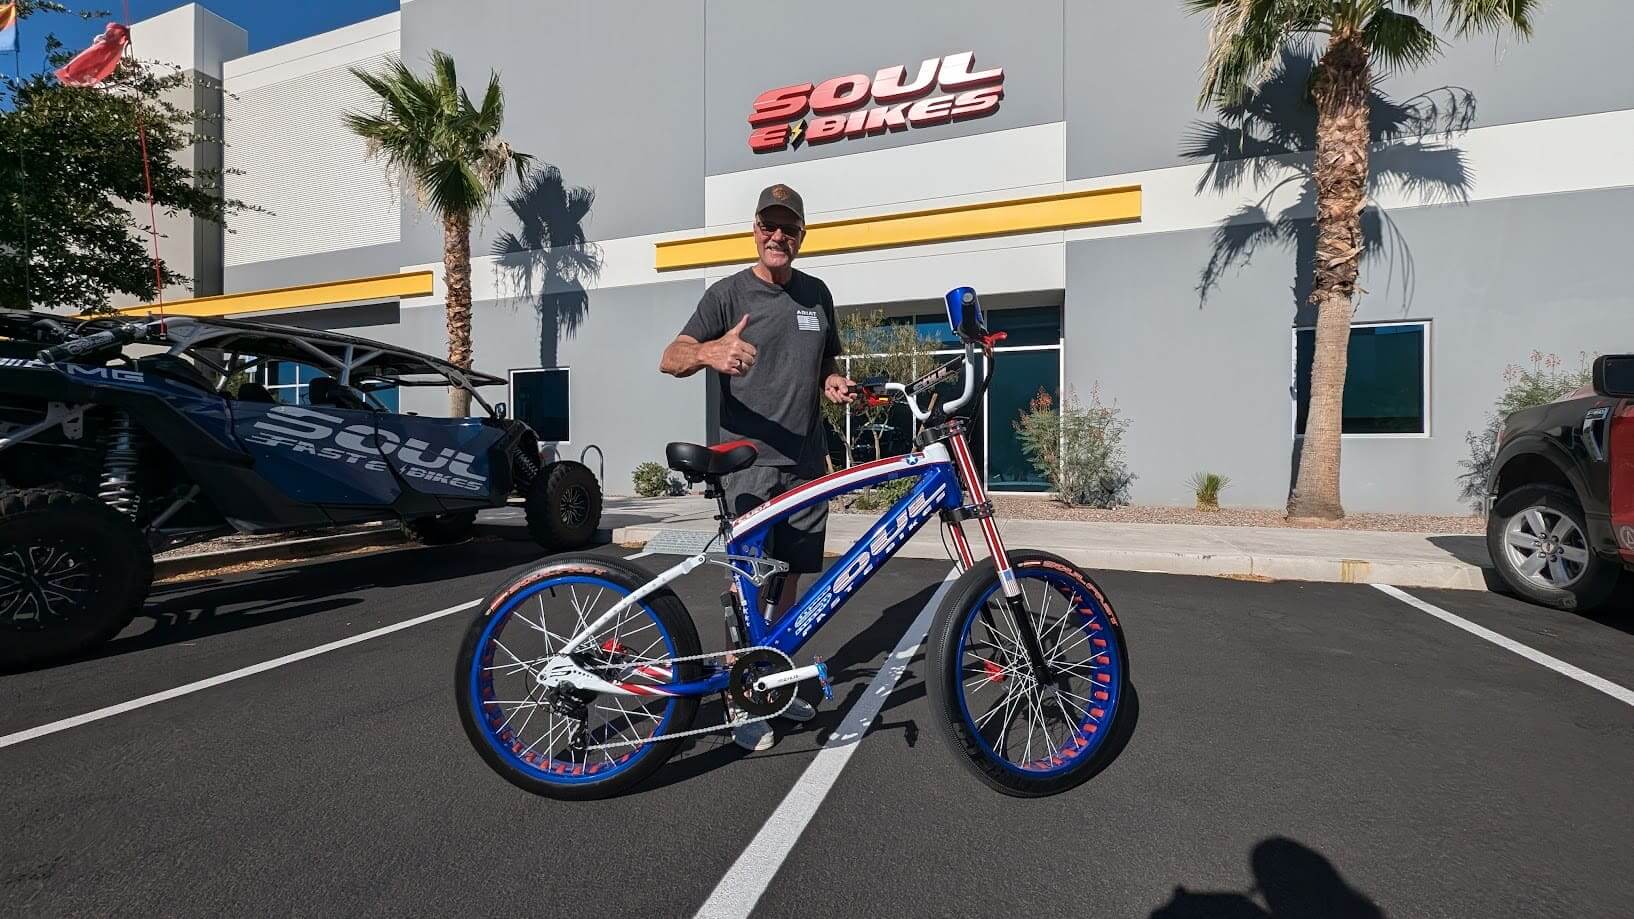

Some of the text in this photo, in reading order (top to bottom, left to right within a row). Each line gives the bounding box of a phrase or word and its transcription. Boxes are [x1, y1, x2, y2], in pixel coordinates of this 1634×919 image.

[747, 51, 1004, 128] SOUL
[245, 432, 368, 464] FAST
[407, 467, 483, 491] BIKES
[253, 405, 487, 482] SOUL
[794, 483, 946, 636] SOUL
